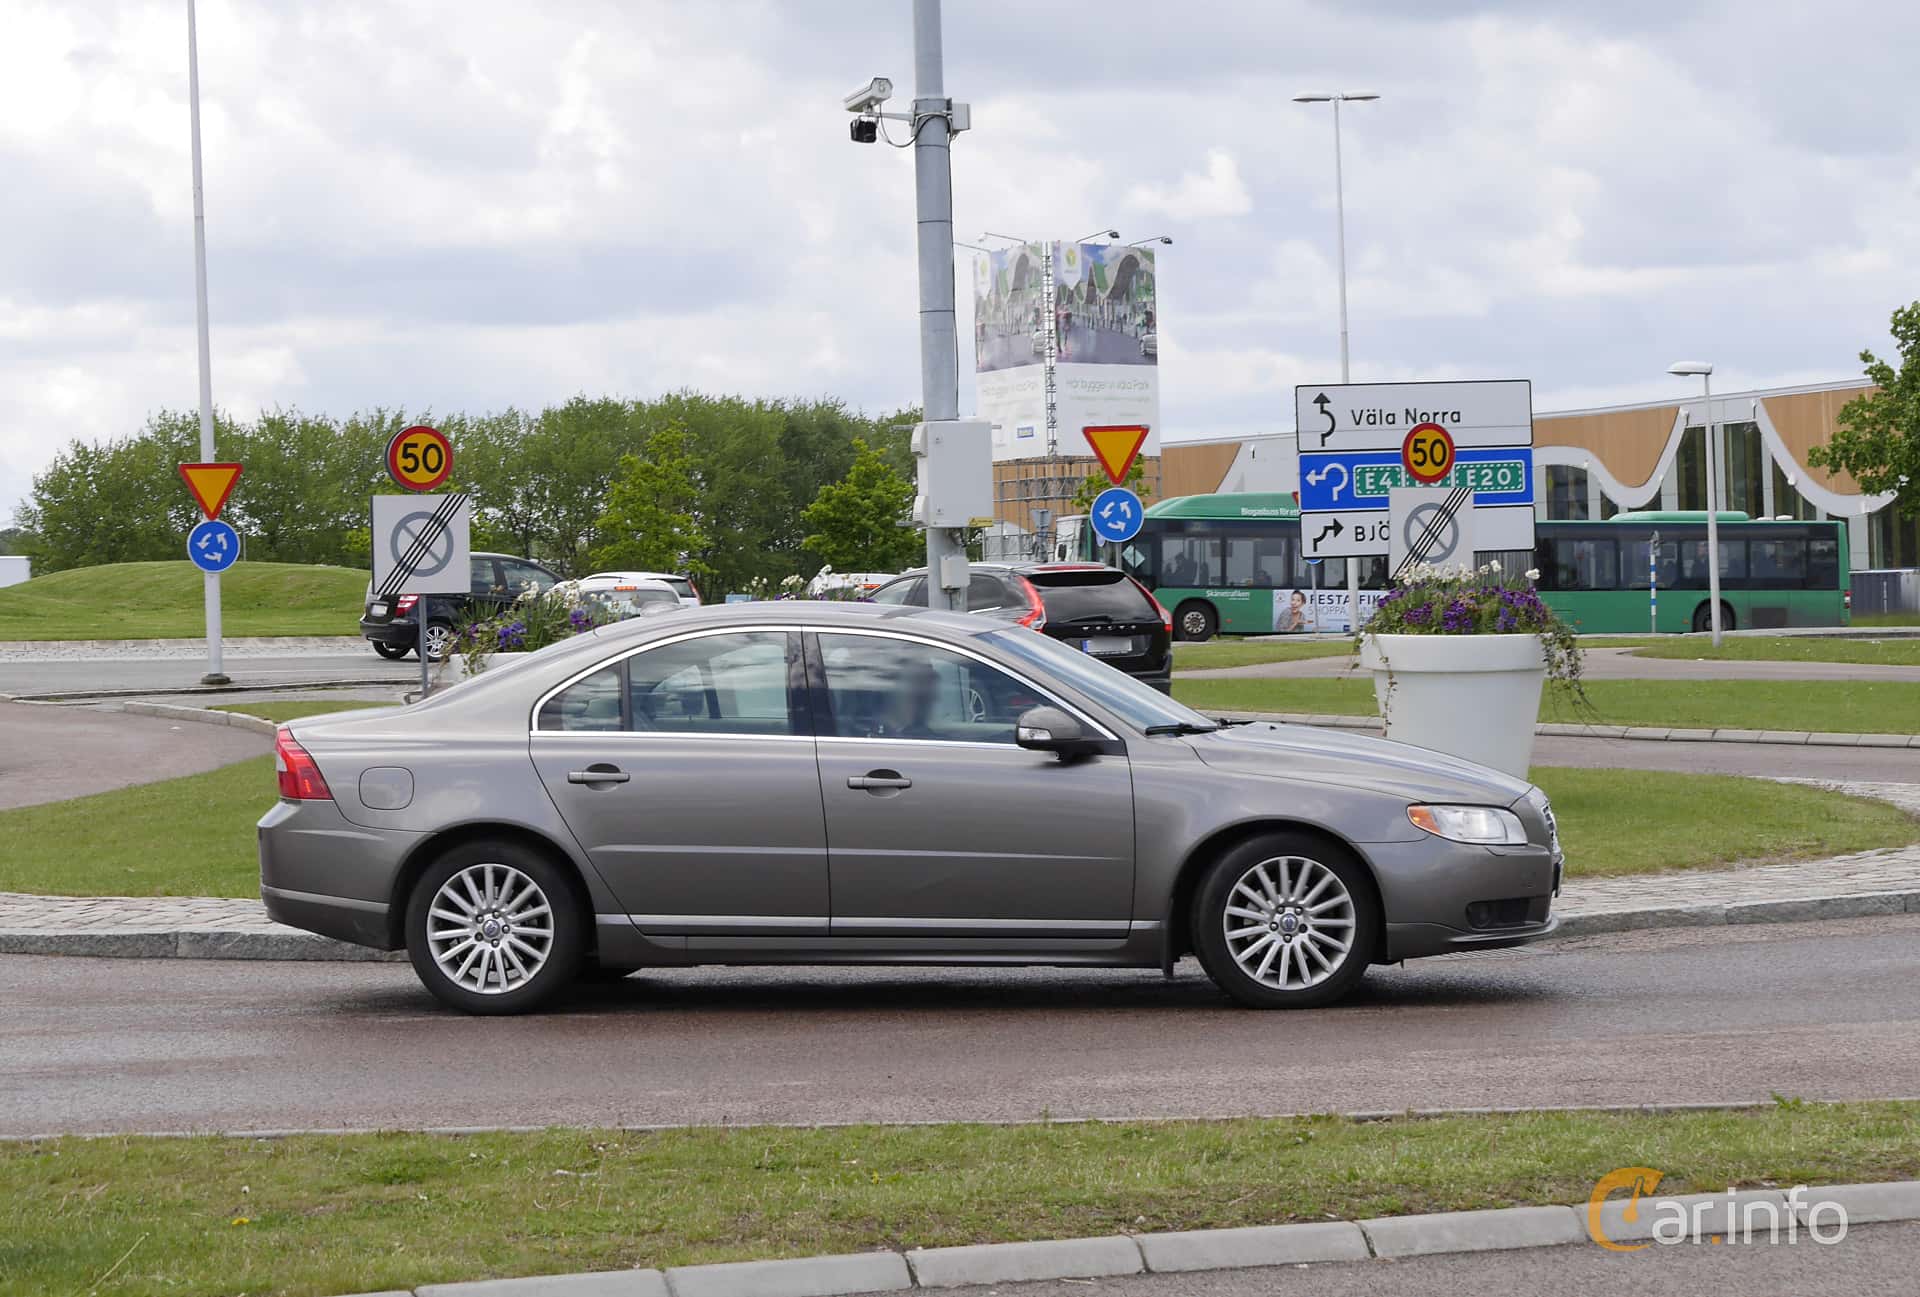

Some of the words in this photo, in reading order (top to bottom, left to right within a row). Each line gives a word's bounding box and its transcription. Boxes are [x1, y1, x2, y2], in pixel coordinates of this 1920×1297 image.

[1351, 409, 1396, 426] Väla
[1405, 408, 1461, 425] Norra
[402, 442, 443, 474] 50
[1412, 438, 1447, 467] 50
[1365, 471, 1392, 490] E4
[1466, 468, 1512, 487] E20
